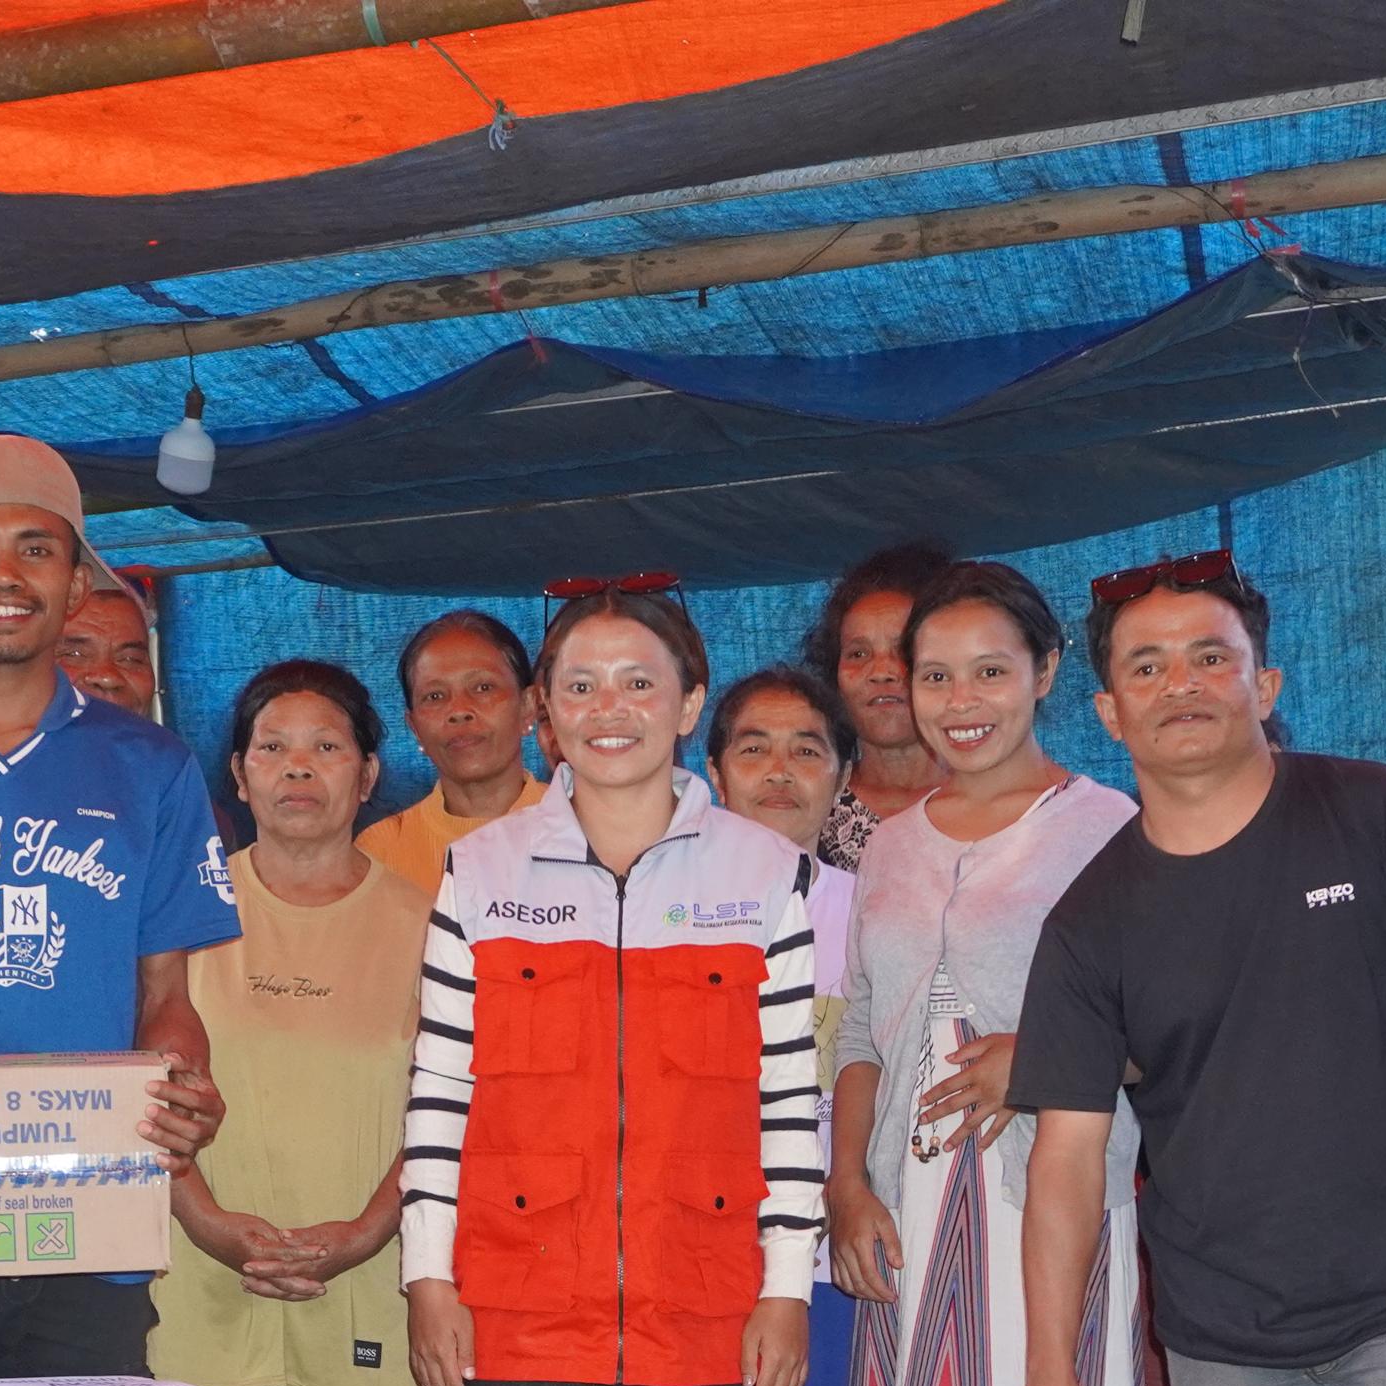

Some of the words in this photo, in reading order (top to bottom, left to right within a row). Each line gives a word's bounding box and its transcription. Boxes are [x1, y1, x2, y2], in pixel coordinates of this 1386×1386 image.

[76, 808, 116, 821] CHAMPION
[12, 816, 126, 901] Yankees
[1305, 882, 1355, 904] KENZO
[1308, 893, 1355, 909] PARIS
[485, 900, 577, 925] ASESOR
[5, 1090, 21, 1111] 8
[30, 1088, 112, 1111] MAKS.
[3, 1196, 30, 1211] seal
[32, 1195, 73, 1210] broken
